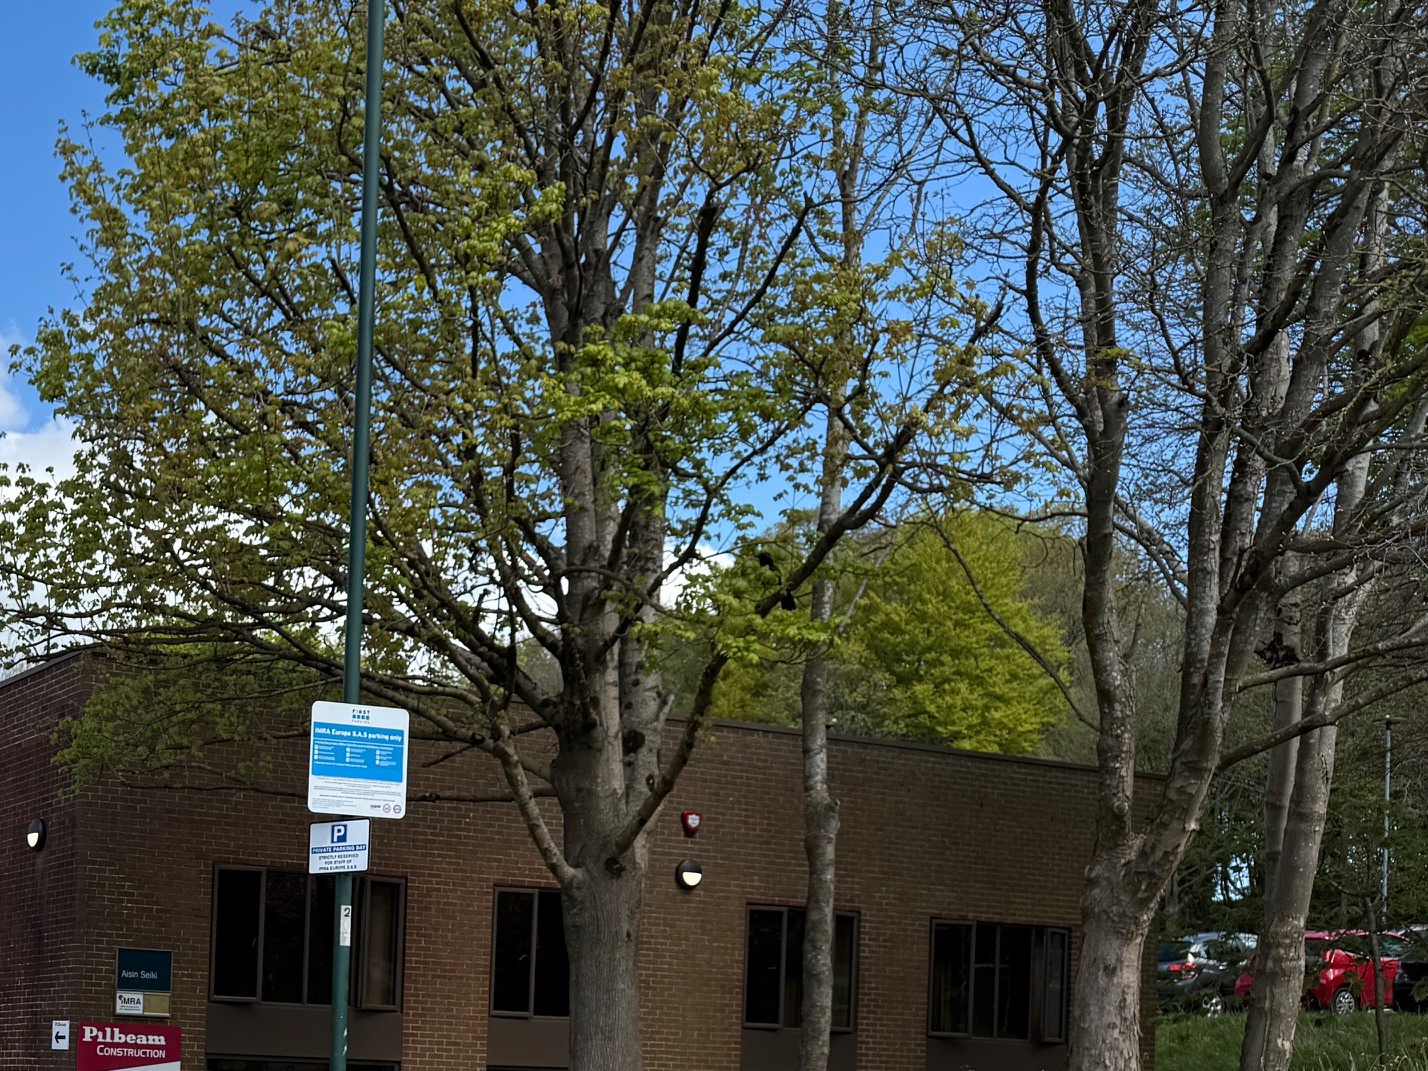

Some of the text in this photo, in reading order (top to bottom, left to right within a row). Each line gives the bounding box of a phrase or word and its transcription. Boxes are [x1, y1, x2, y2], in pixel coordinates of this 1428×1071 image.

[315, 727, 331, 735] IMRA
[332, 728, 351, 737] Europe
[368, 732, 389, 741] parking
[333, 825, 345, 842] P
[344, 907, 351, 917] 2
[121, 970, 158, 979] Aisin Seiki
[82, 1026, 166, 1045] Pilbeam
[96, 1045, 166, 1058] CONSTRUCTION
